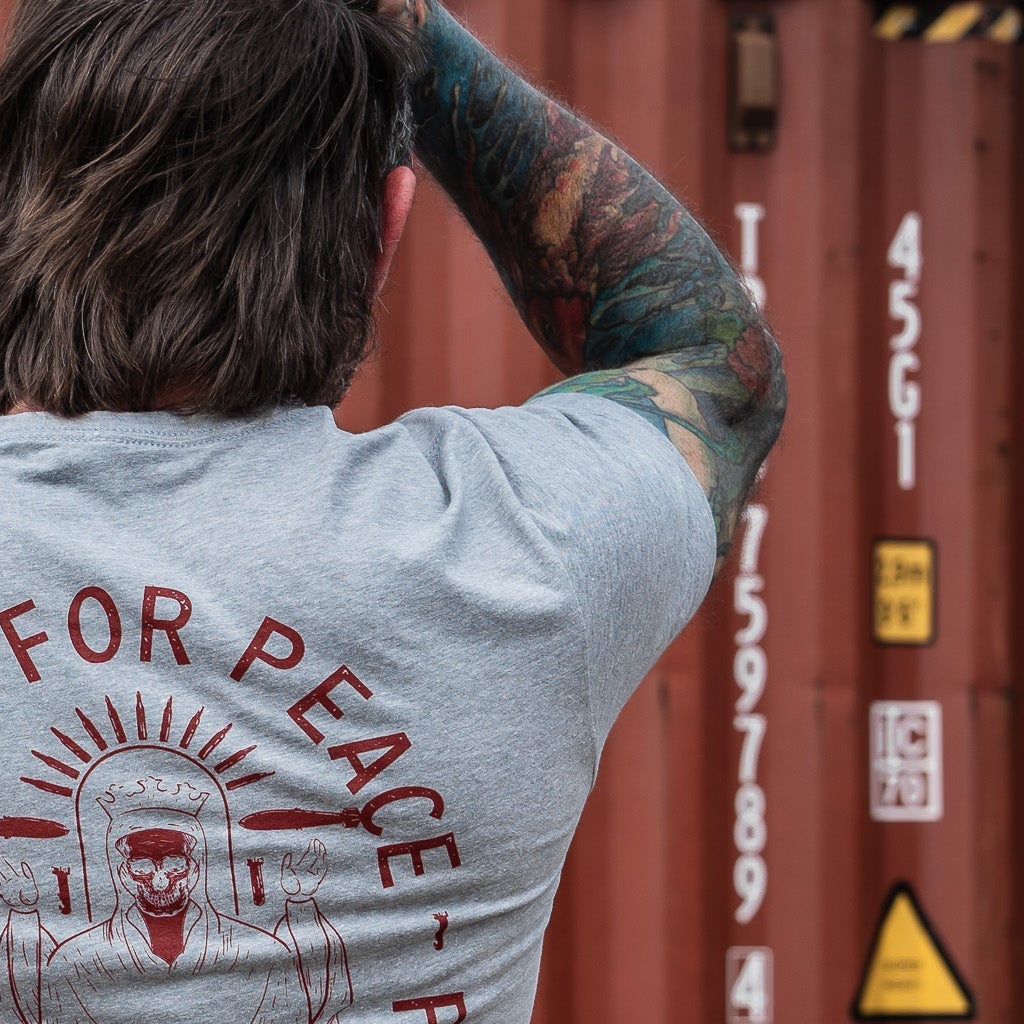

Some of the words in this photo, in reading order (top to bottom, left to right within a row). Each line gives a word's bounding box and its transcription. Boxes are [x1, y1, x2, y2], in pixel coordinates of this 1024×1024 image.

[887, 211, 925, 490] 45G1
[230, 616, 462, 889] PEACE
[731, 952, 766, 1024] 4
